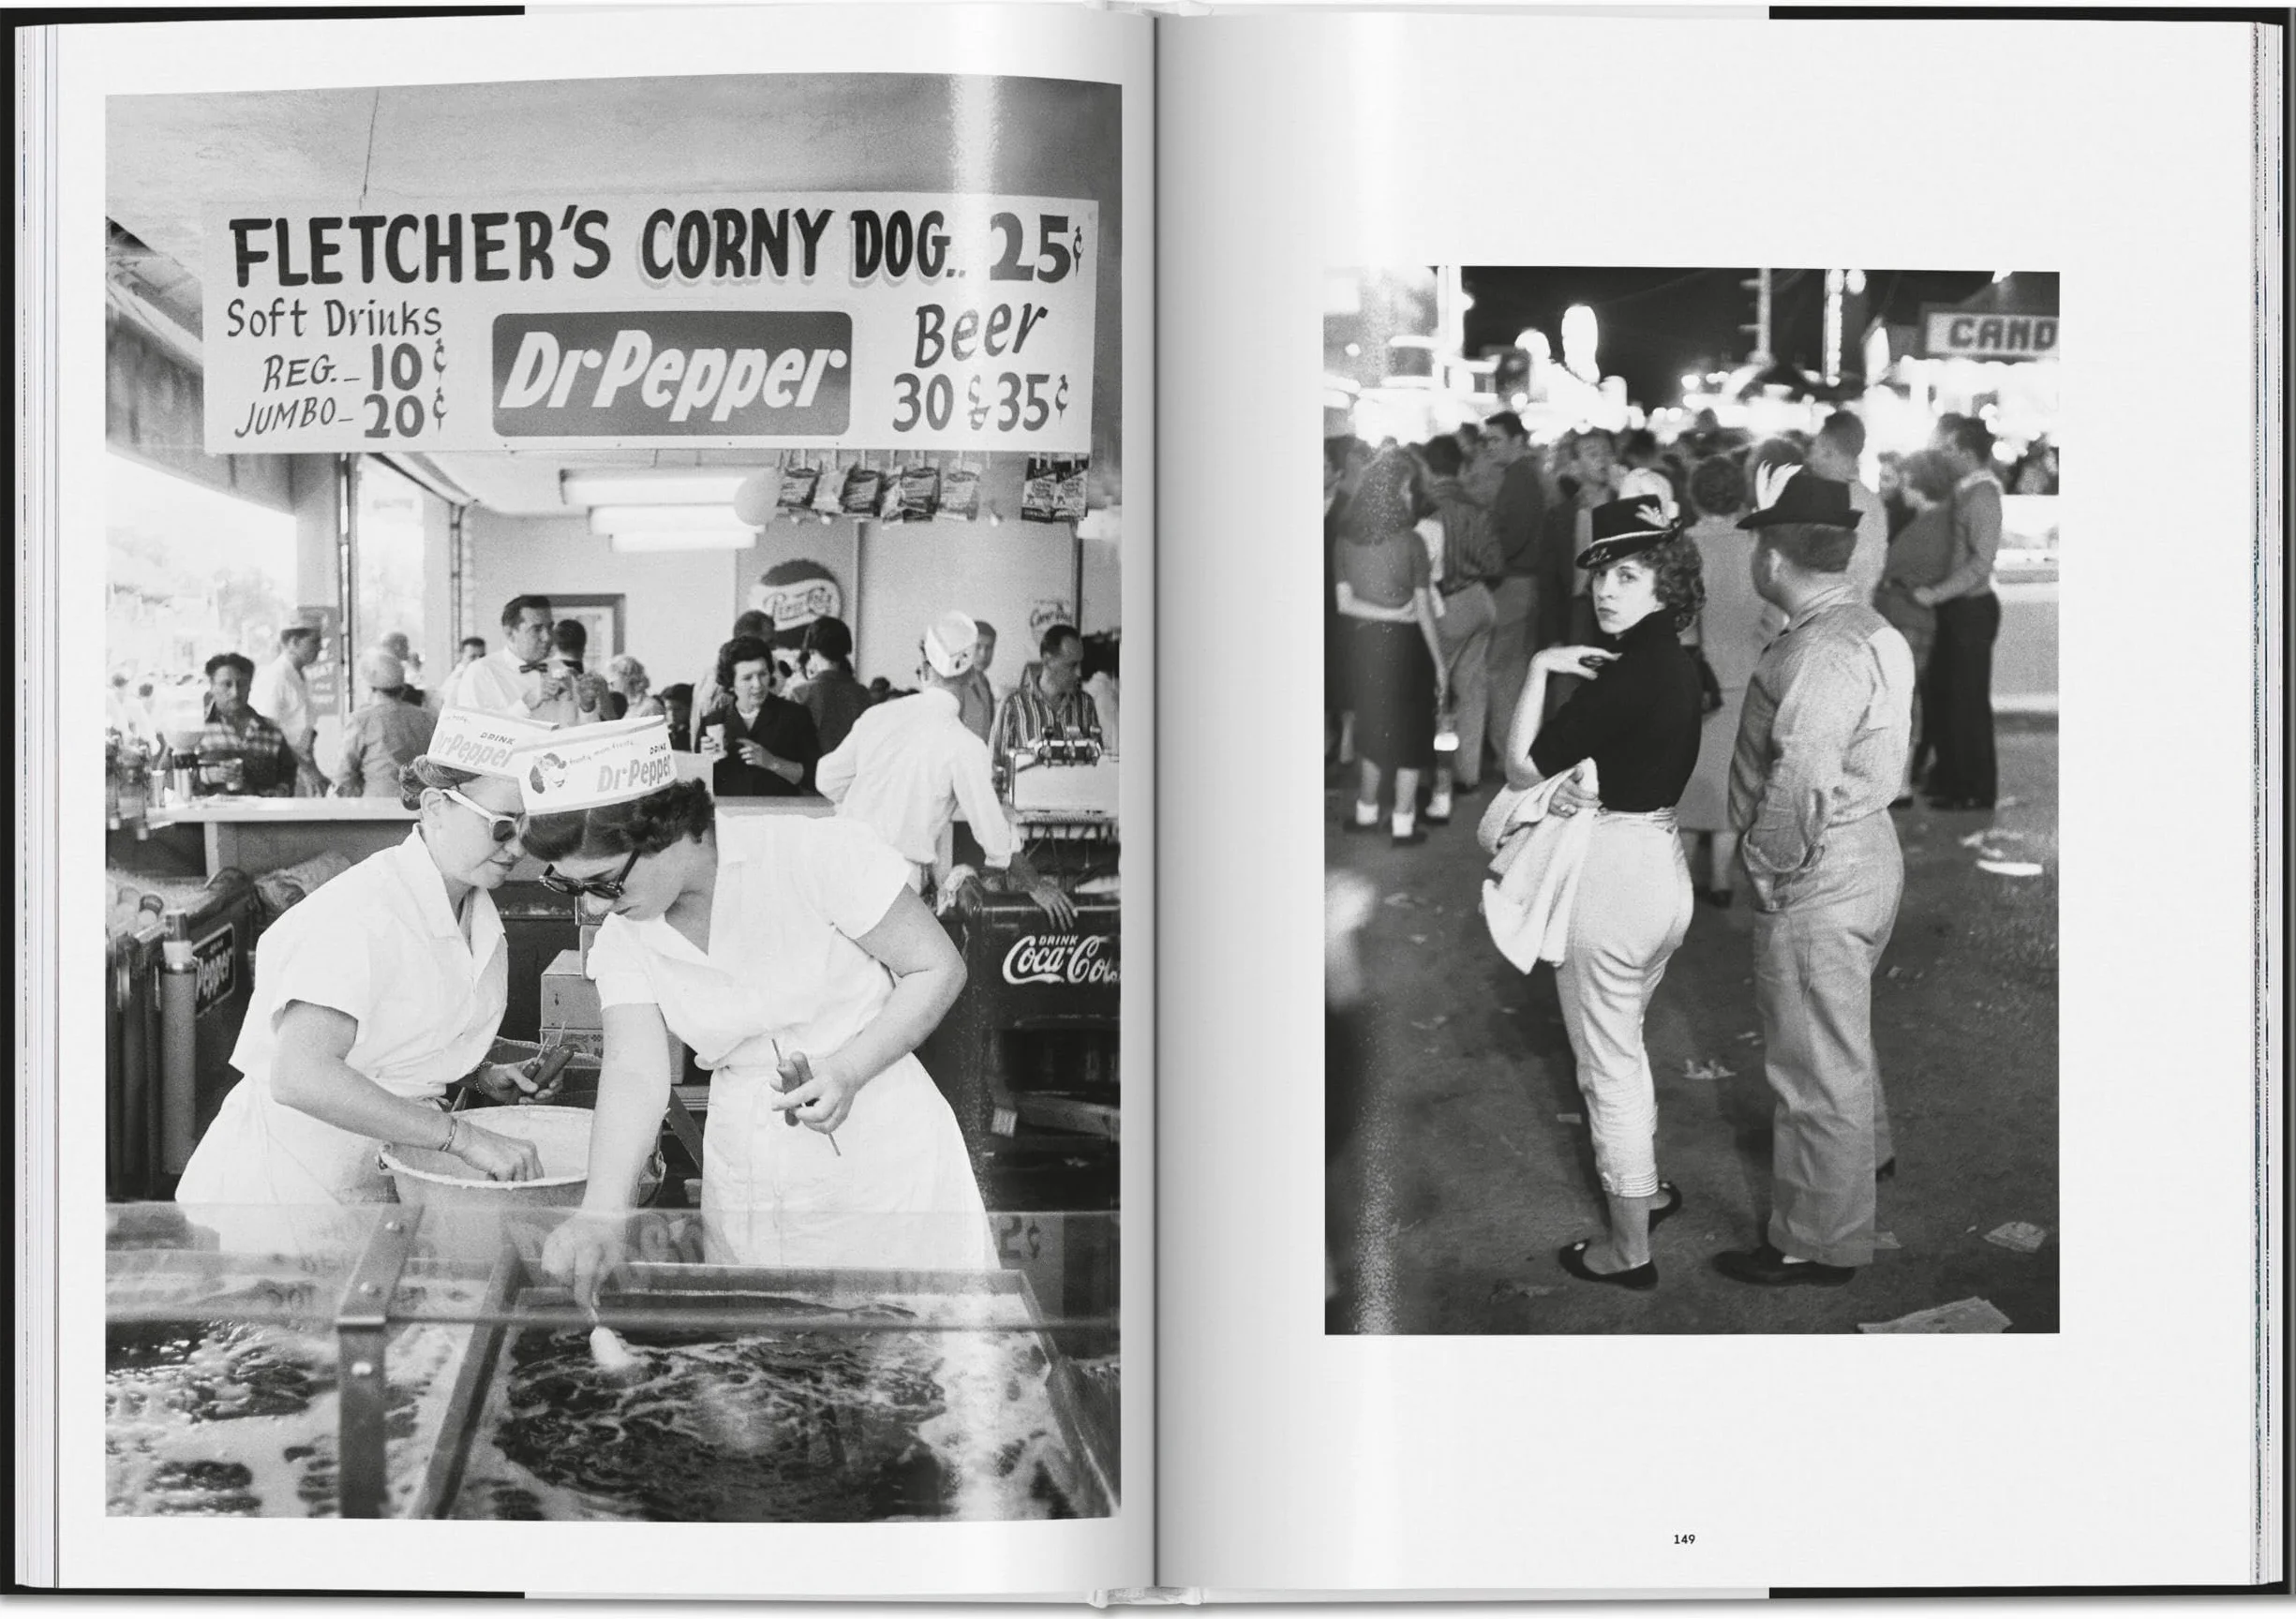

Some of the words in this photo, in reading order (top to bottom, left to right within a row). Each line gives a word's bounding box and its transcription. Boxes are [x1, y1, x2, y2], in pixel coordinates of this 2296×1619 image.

[229, 204, 611, 288] FLETCHER'S
[641, 207, 835, 280] CORNY
[227, 298, 307, 337] Soft
[323, 299, 442, 336] Drinks
[914, 302, 1049, 369] Beer
[892, 373, 954, 433] 30
[480, 732, 516, 746] DRINK
[1038, 935, 1079, 946] DRINK
[1674, 1534, 1695, 1545] 149
